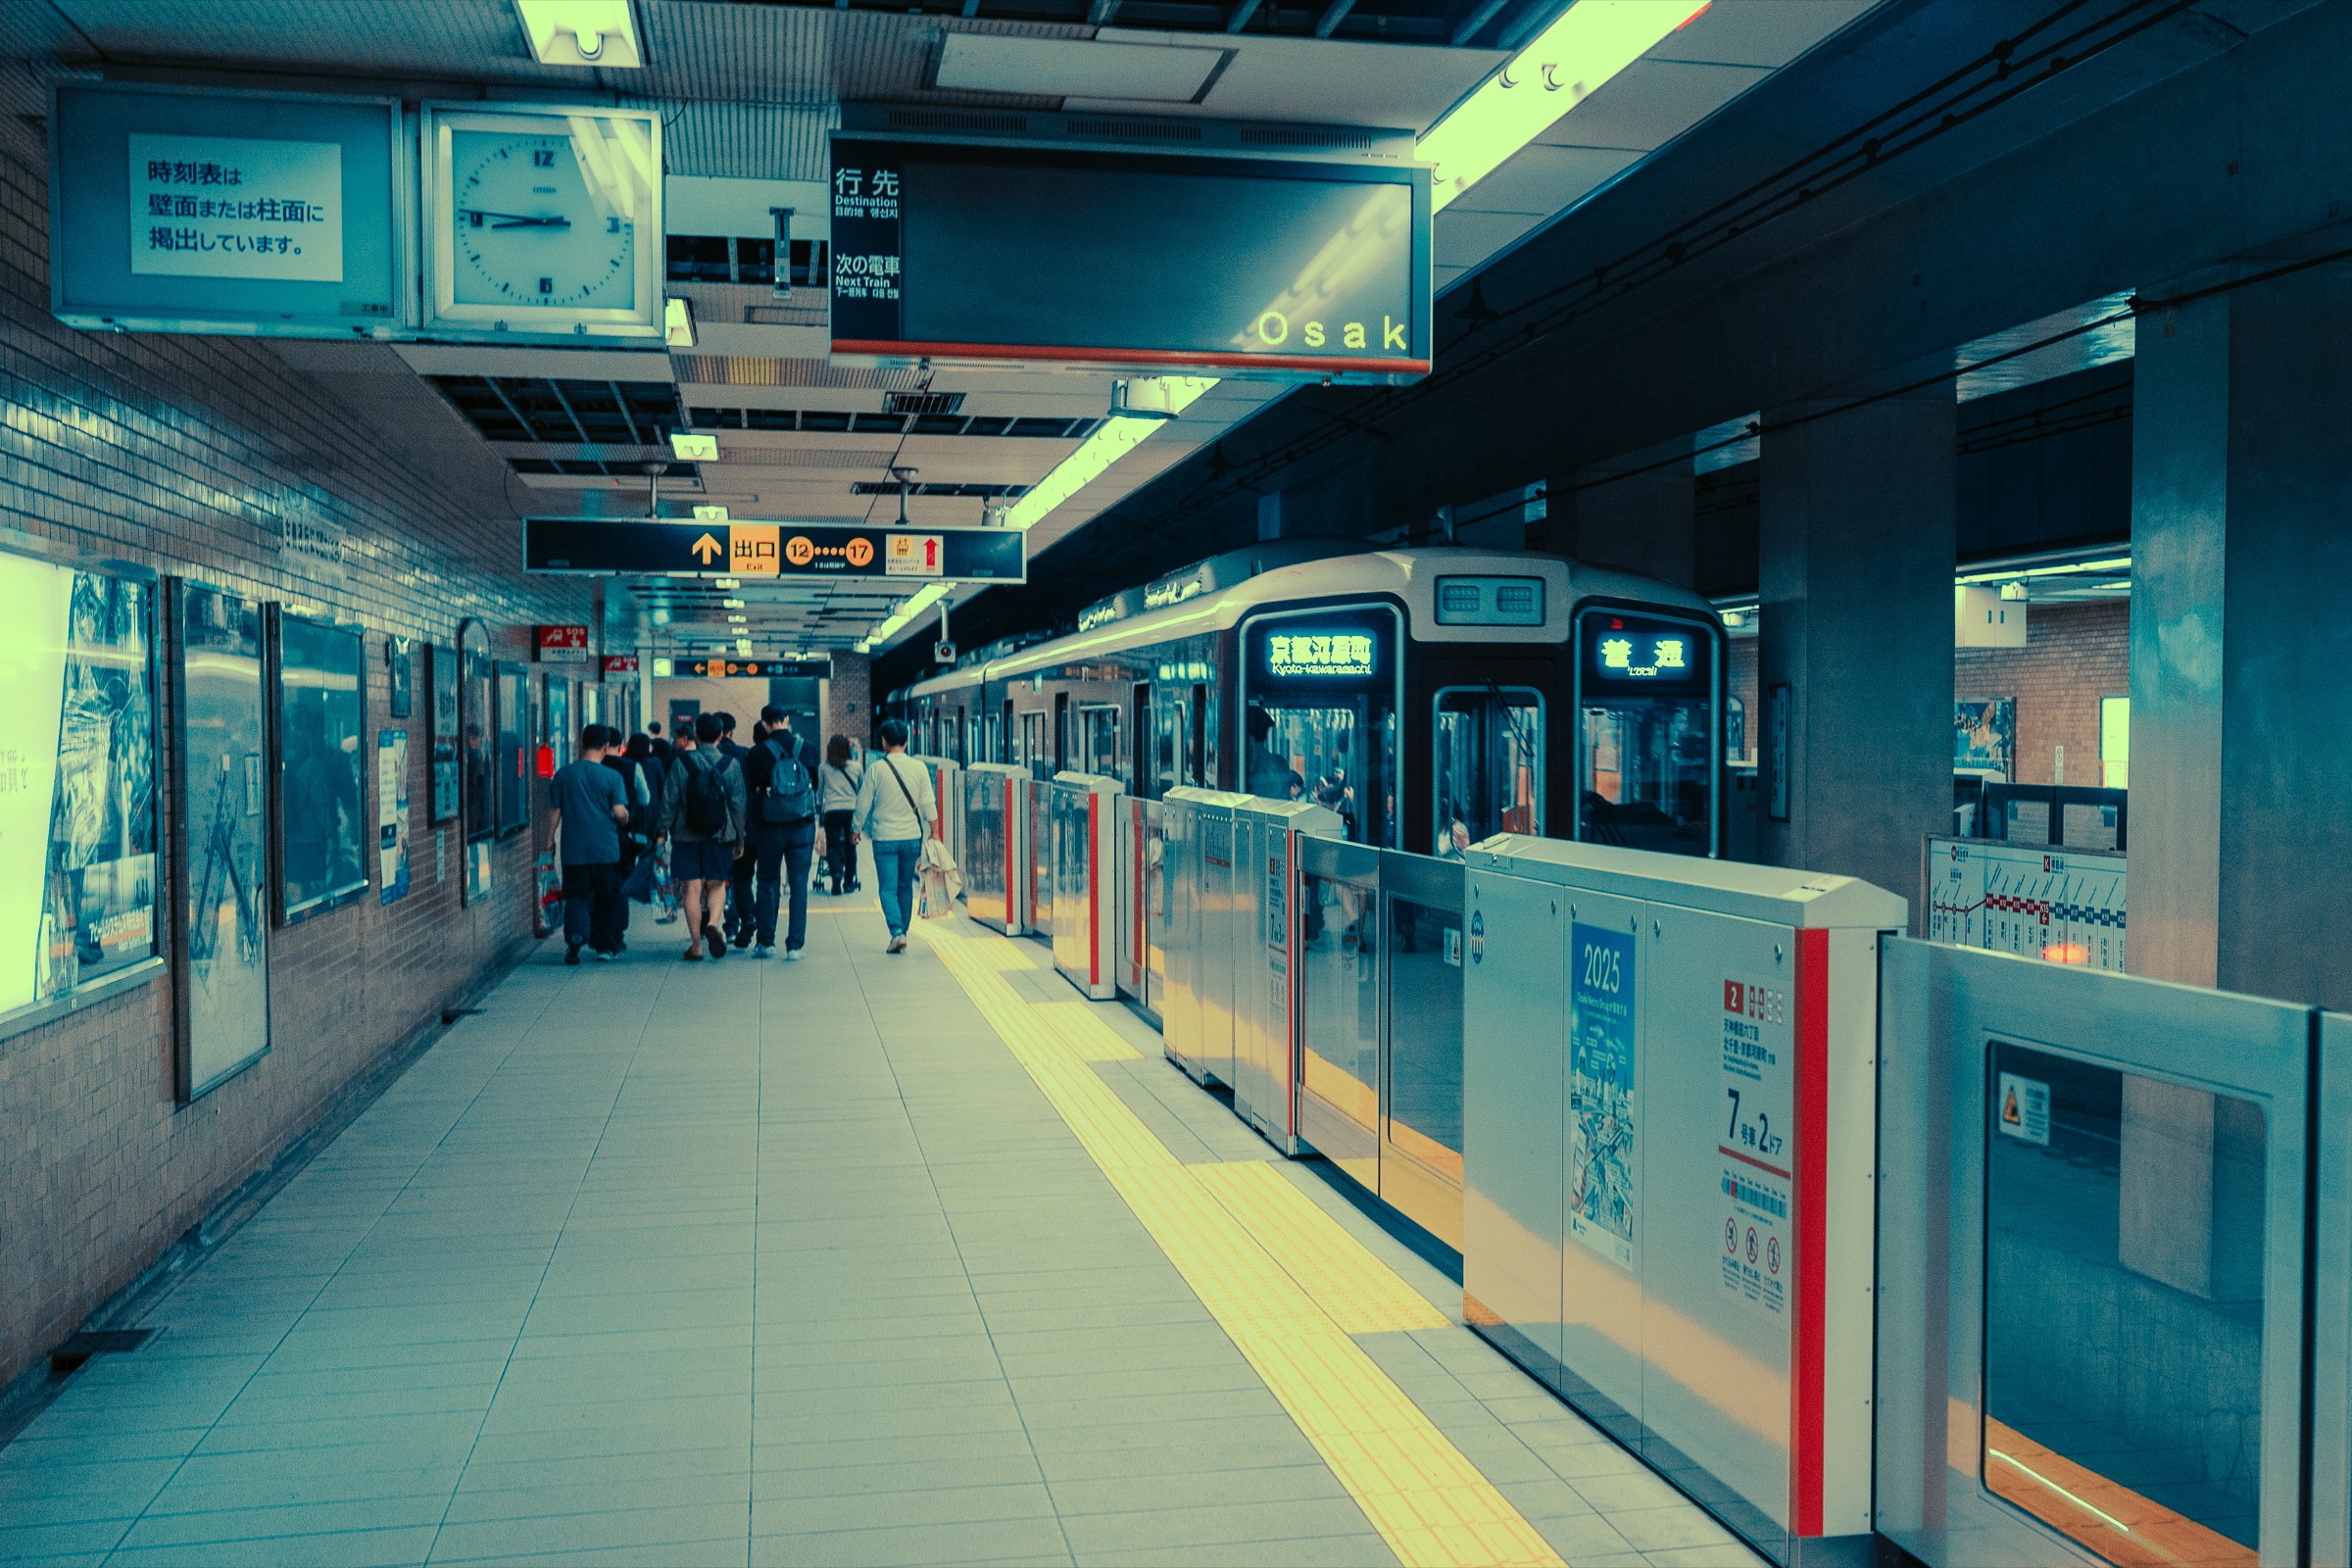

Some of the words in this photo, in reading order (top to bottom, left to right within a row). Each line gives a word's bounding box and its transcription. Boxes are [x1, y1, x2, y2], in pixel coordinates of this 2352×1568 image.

[534, 150, 555, 168] 12
[148, 160, 242, 185] 時刻表は
[836, 167, 900, 196] 行先
[148, 193, 324, 222] 壁面または柱面に
[835, 194, 898, 208] Destination
[149, 226, 302, 255] 掲出しています。
[836, 253, 901, 277] 次の電車
[539, 276, 553, 294] 6
[835, 275, 861, 287] Next
[862, 275, 890, 288] Train
[734, 540, 775, 559] 出口
[790, 543, 810, 559] 12
[850, 545, 869, 560] 17
[746, 563, 762, 571] Exit
[1269, 635, 1372, 664] 京都河原町
[1600, 638, 1686, 668] 普通
[2039, 903, 2049, 913] K15
[1584, 943, 1621, 994] 2025
[1731, 985, 1738, 1008] 2
